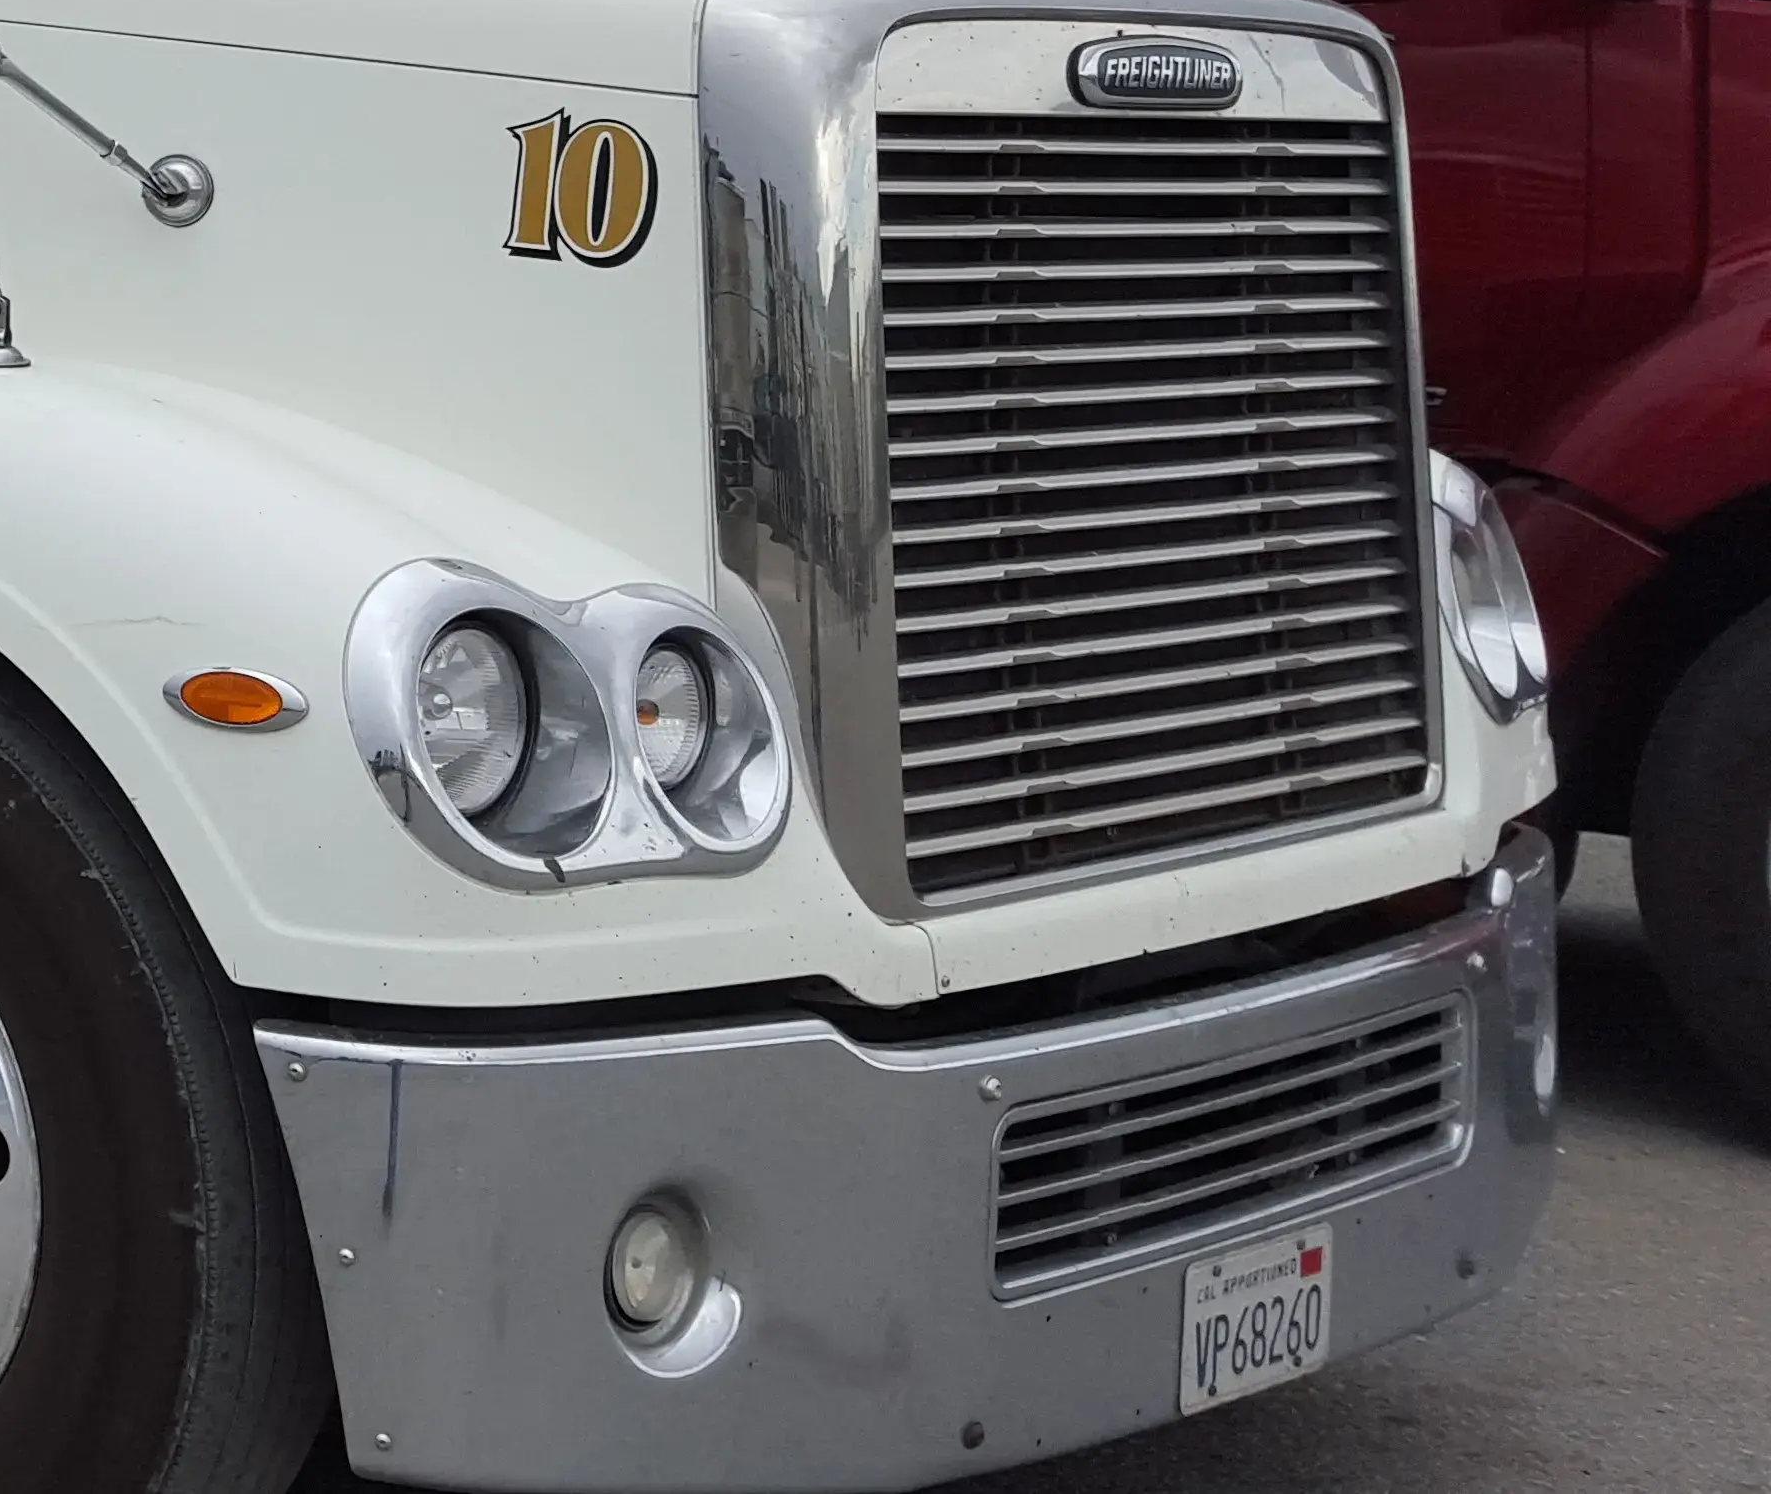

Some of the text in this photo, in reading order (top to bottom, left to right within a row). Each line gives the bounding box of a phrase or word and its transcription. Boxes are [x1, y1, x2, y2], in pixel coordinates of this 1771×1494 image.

[1104, 56, 1233, 89] FREIGHTLINER
[502, 106, 659, 269] 10
[1195, 1283, 1322, 1390] VP68260
